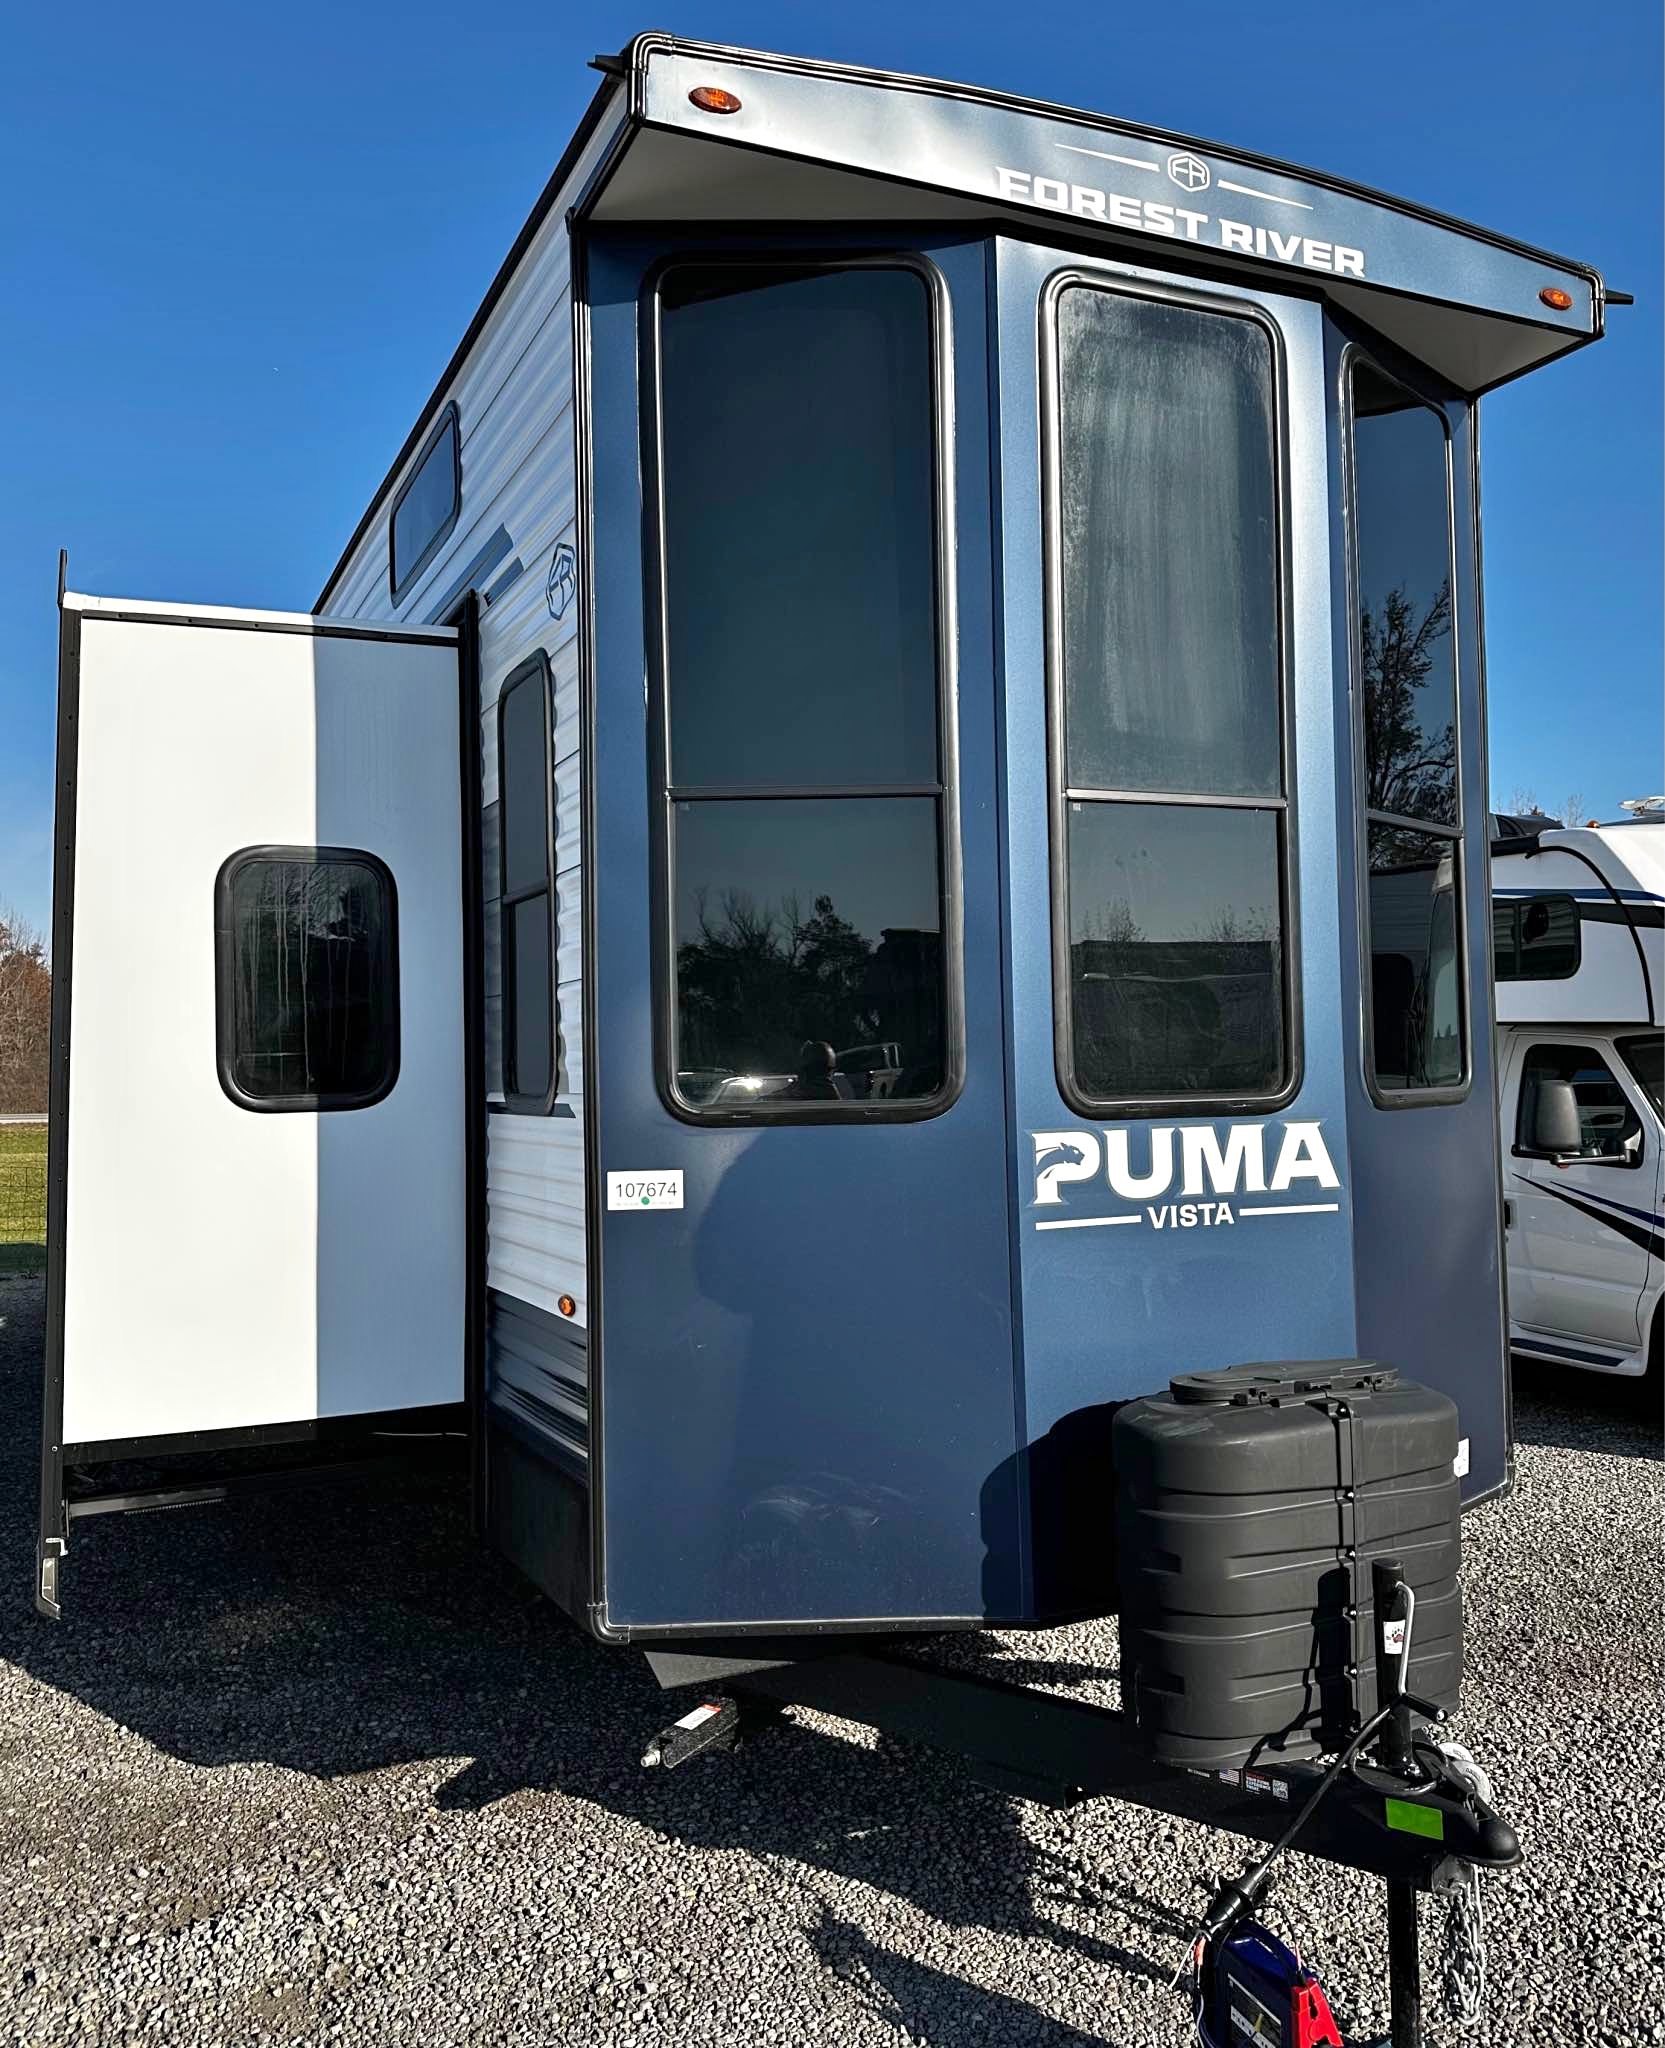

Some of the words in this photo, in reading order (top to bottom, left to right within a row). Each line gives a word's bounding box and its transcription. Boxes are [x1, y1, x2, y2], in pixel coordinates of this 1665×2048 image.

[1172, 157, 1206, 187] FR
[996, 166, 1208, 241] FOREST
[1218, 217, 1366, 279] RIVER
[1029, 1121, 1343, 1205] PUMA
[615, 1181, 678, 1198] 107674
[1147, 1202, 1235, 1230] VISTA
